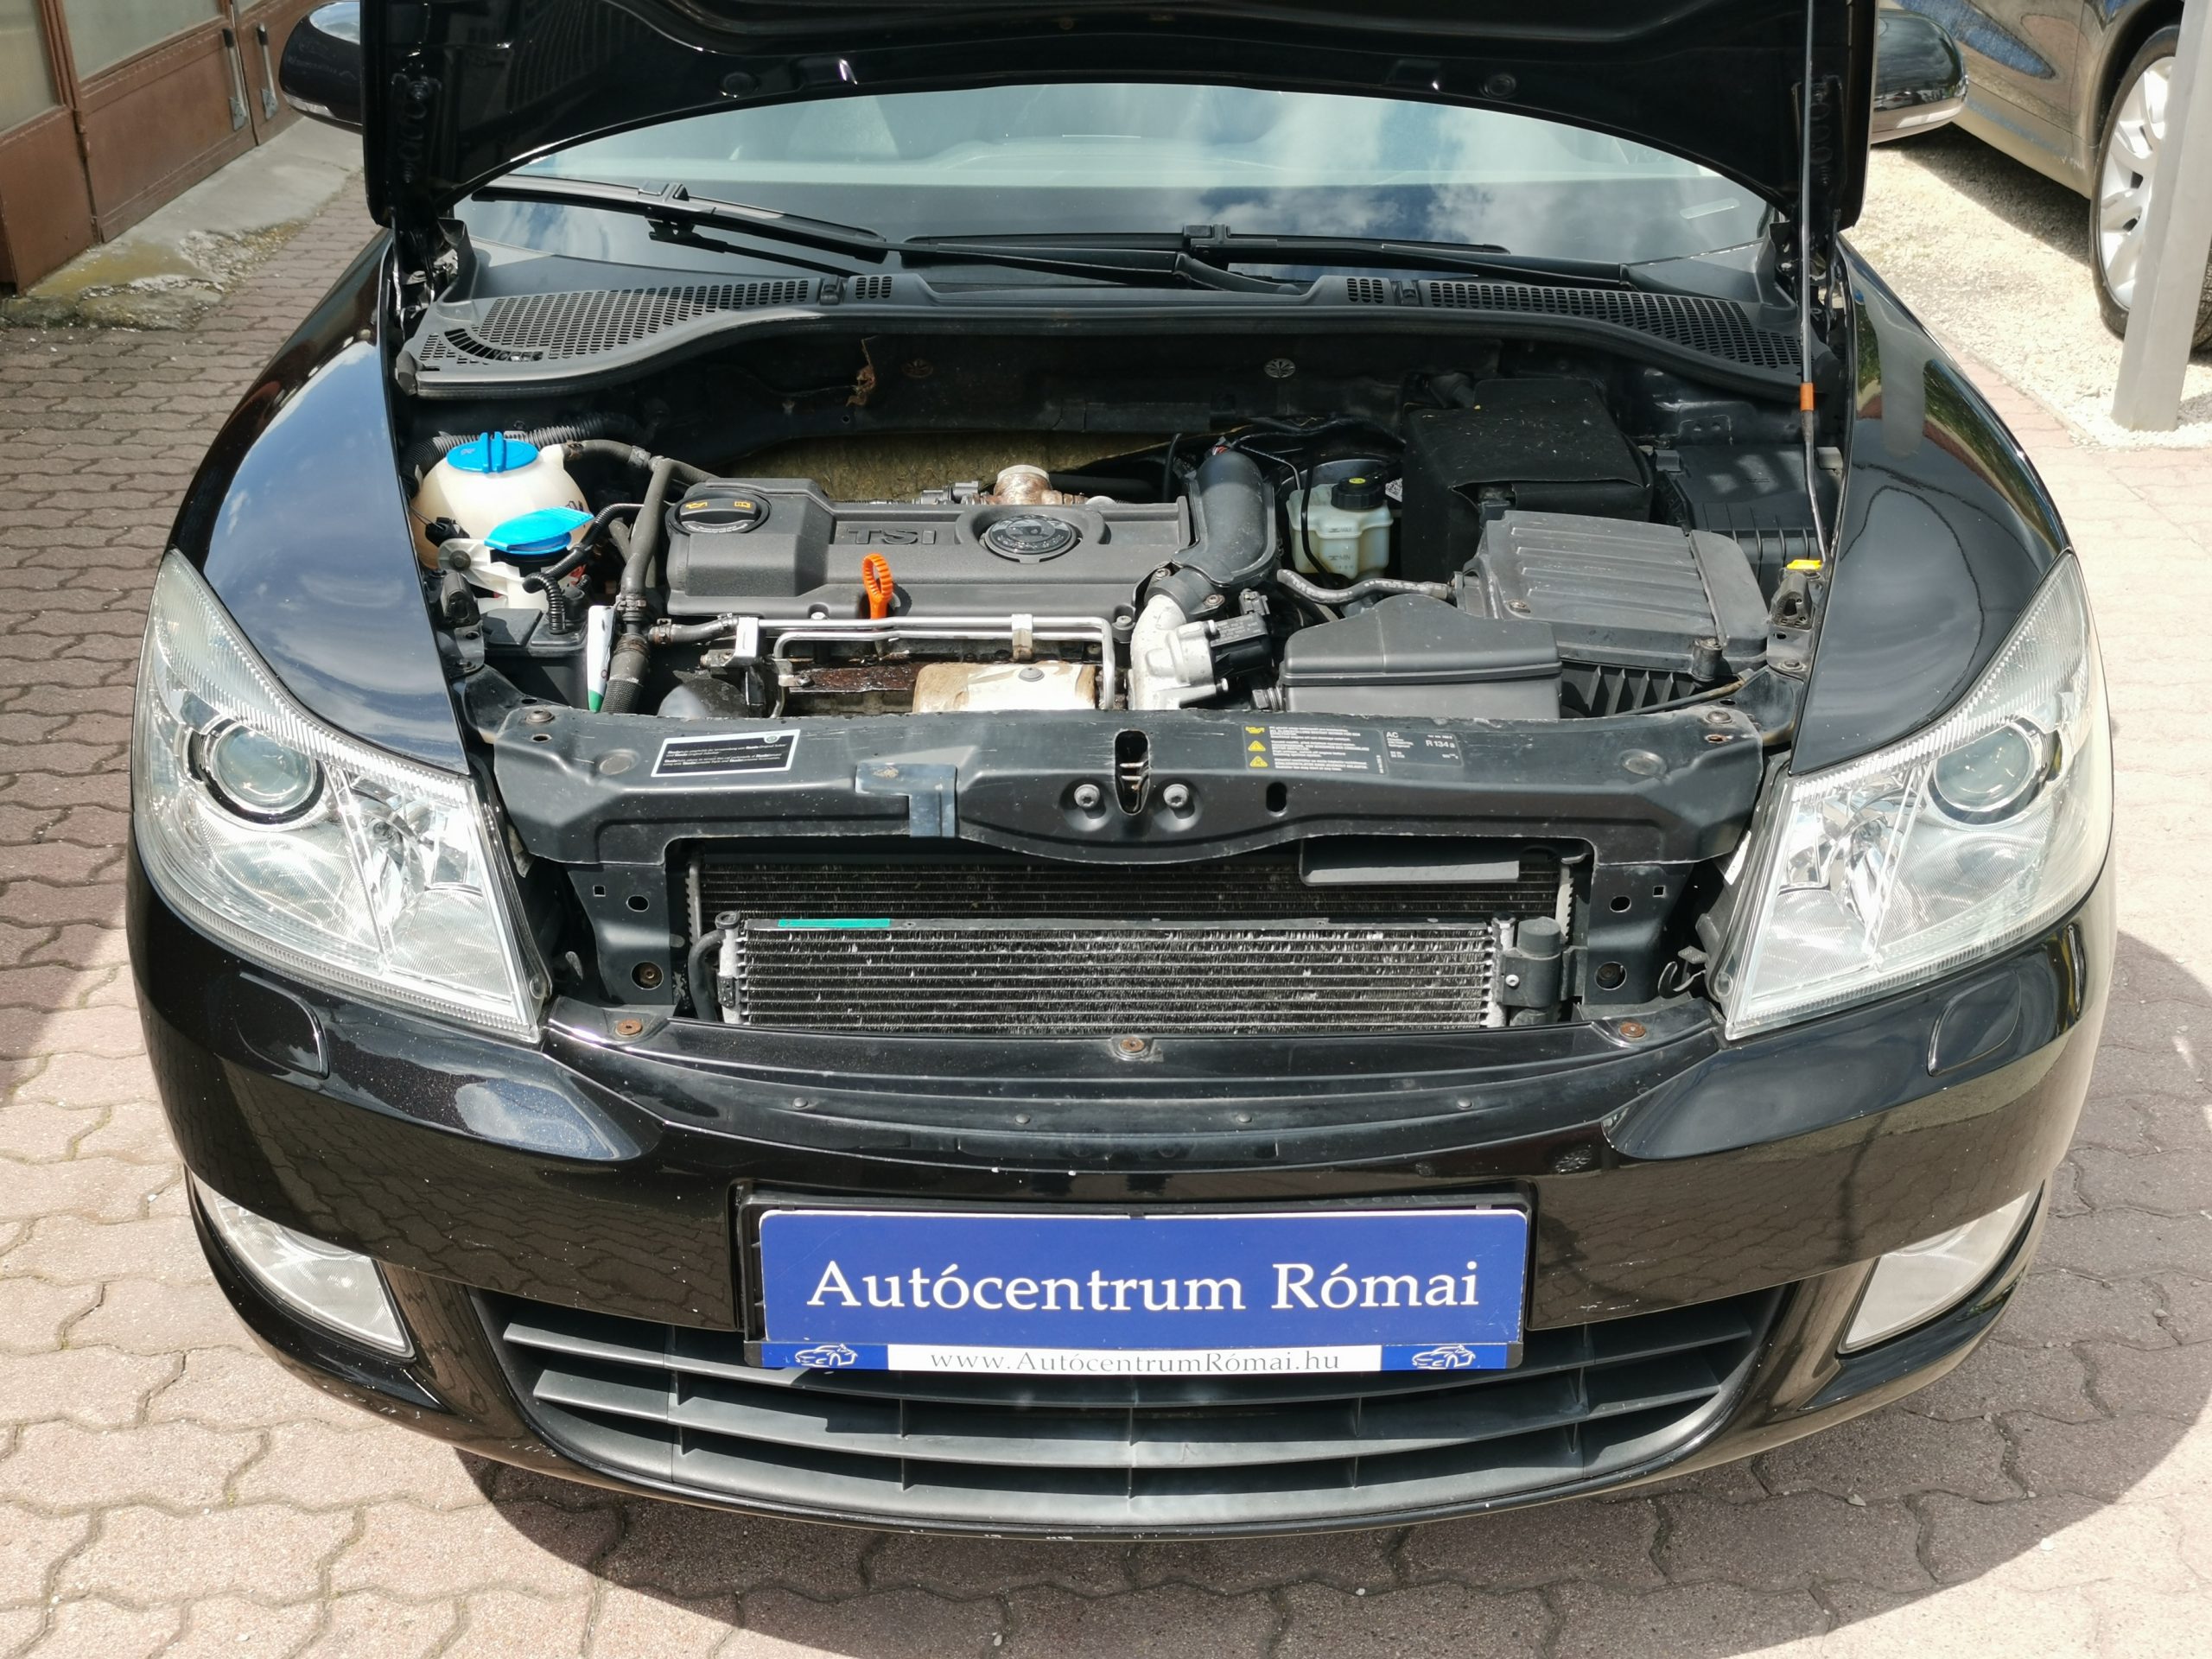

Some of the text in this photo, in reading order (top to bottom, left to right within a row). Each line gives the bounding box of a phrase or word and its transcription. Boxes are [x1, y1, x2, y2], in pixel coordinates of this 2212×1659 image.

[847, 527, 937, 544] TSI
[806, 1260, 1479, 1312] Autócentrum Római
[931, 1350, 1339, 1372] www.AutócentrumRómai.hu
